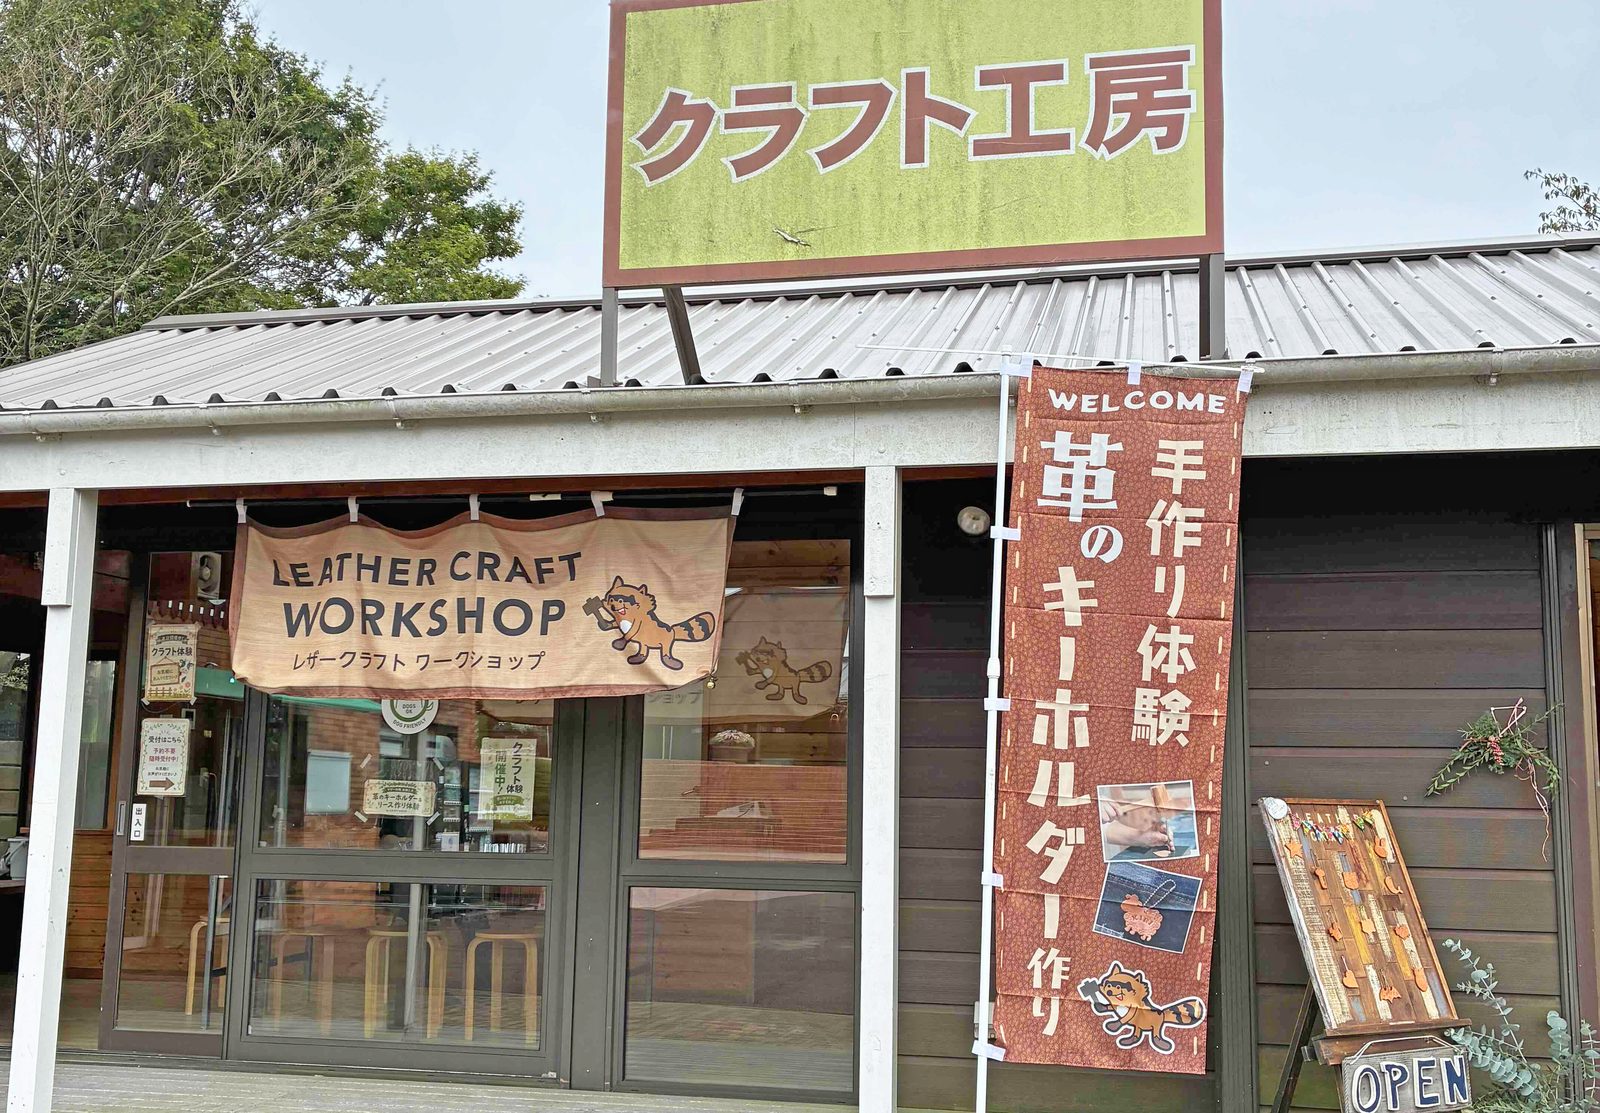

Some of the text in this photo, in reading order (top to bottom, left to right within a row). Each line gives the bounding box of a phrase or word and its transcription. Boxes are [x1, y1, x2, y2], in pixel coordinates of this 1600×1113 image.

[630, 44, 1197, 188] クラフト工房
[1048, 388, 1227, 414] WELCOME
[272, 550, 583, 588] LEATHER CRAFT
[283, 597, 567, 638] WORKSHOP
[151, 647, 193, 656] クラフト体験
[292, 650, 547, 671] レザークラフト ワークショップ
[392, 717, 427, 729] DOG FRIENDLY
[148, 736, 183, 744] 受付はこちら
[153, 747, 176, 755] 予約不要
[133, 807, 143, 838] 出入口
[1351, 1055, 1469, 1113] OPEN
